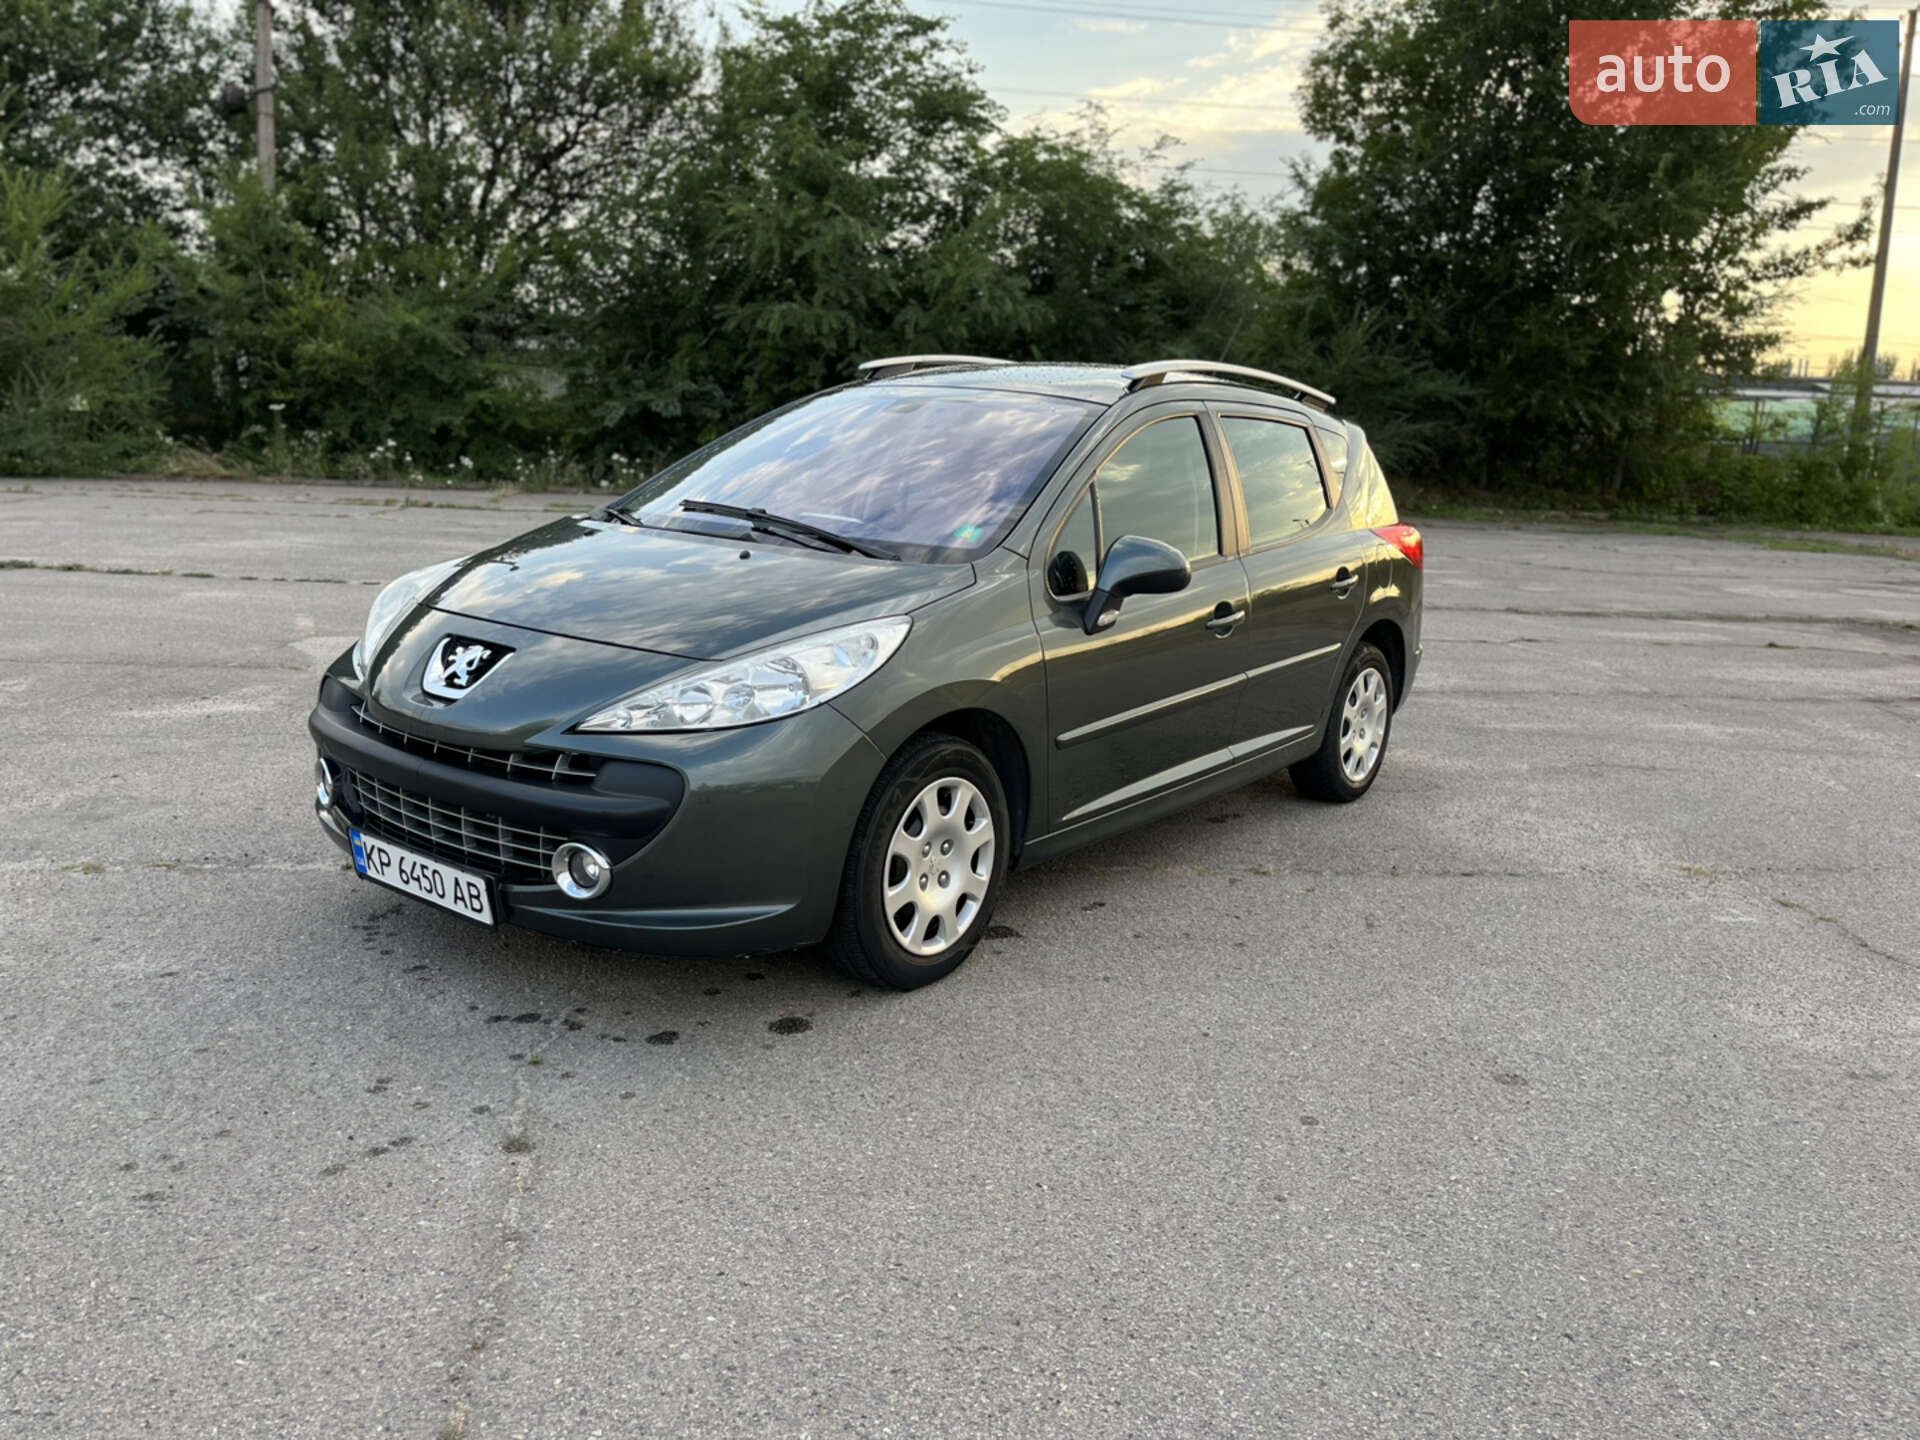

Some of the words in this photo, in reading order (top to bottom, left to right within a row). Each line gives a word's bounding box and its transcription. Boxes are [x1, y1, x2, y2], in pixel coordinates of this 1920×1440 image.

[364, 841, 391, 876] KP
[399, 856, 446, 899] 6450
[454, 876, 484, 913] AB
